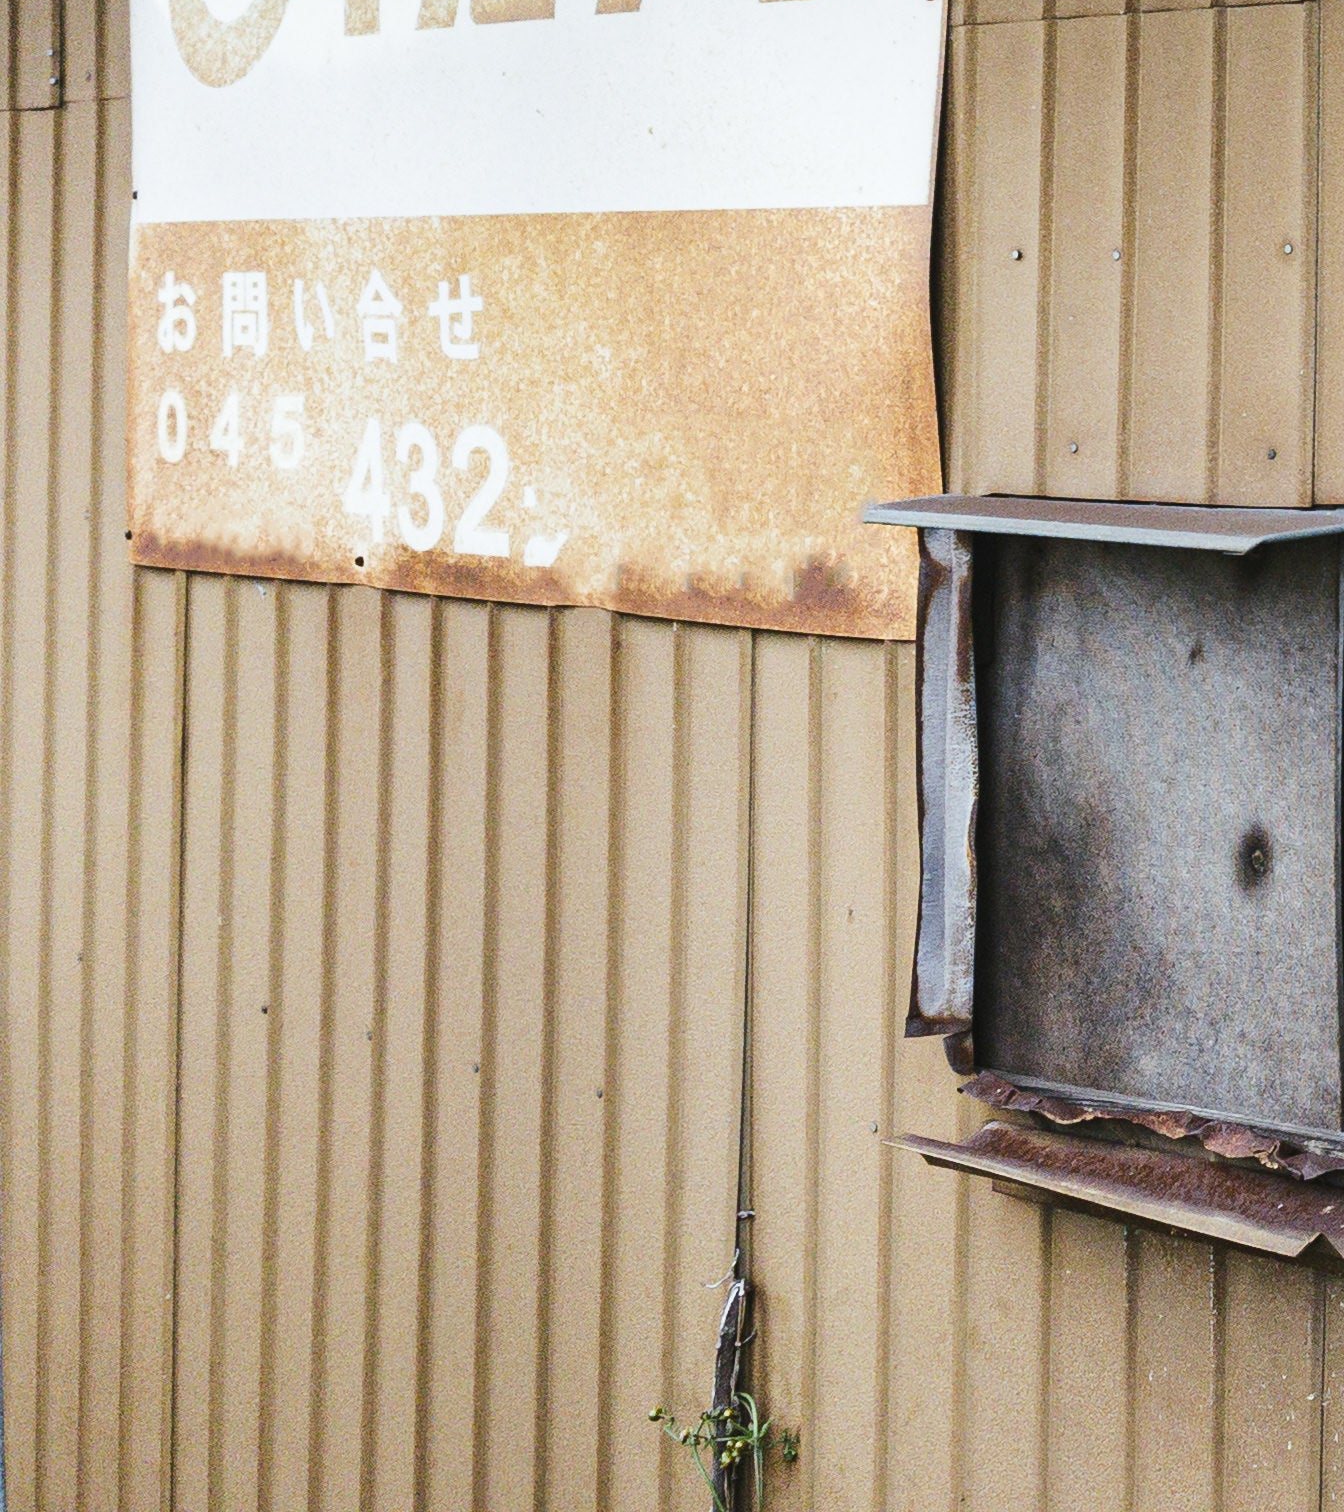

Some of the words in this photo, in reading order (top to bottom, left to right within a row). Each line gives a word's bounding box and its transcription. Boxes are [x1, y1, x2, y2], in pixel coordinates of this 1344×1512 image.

[157, 268, 484, 363] お問い合せ
[157, 391, 304, 469] 045
